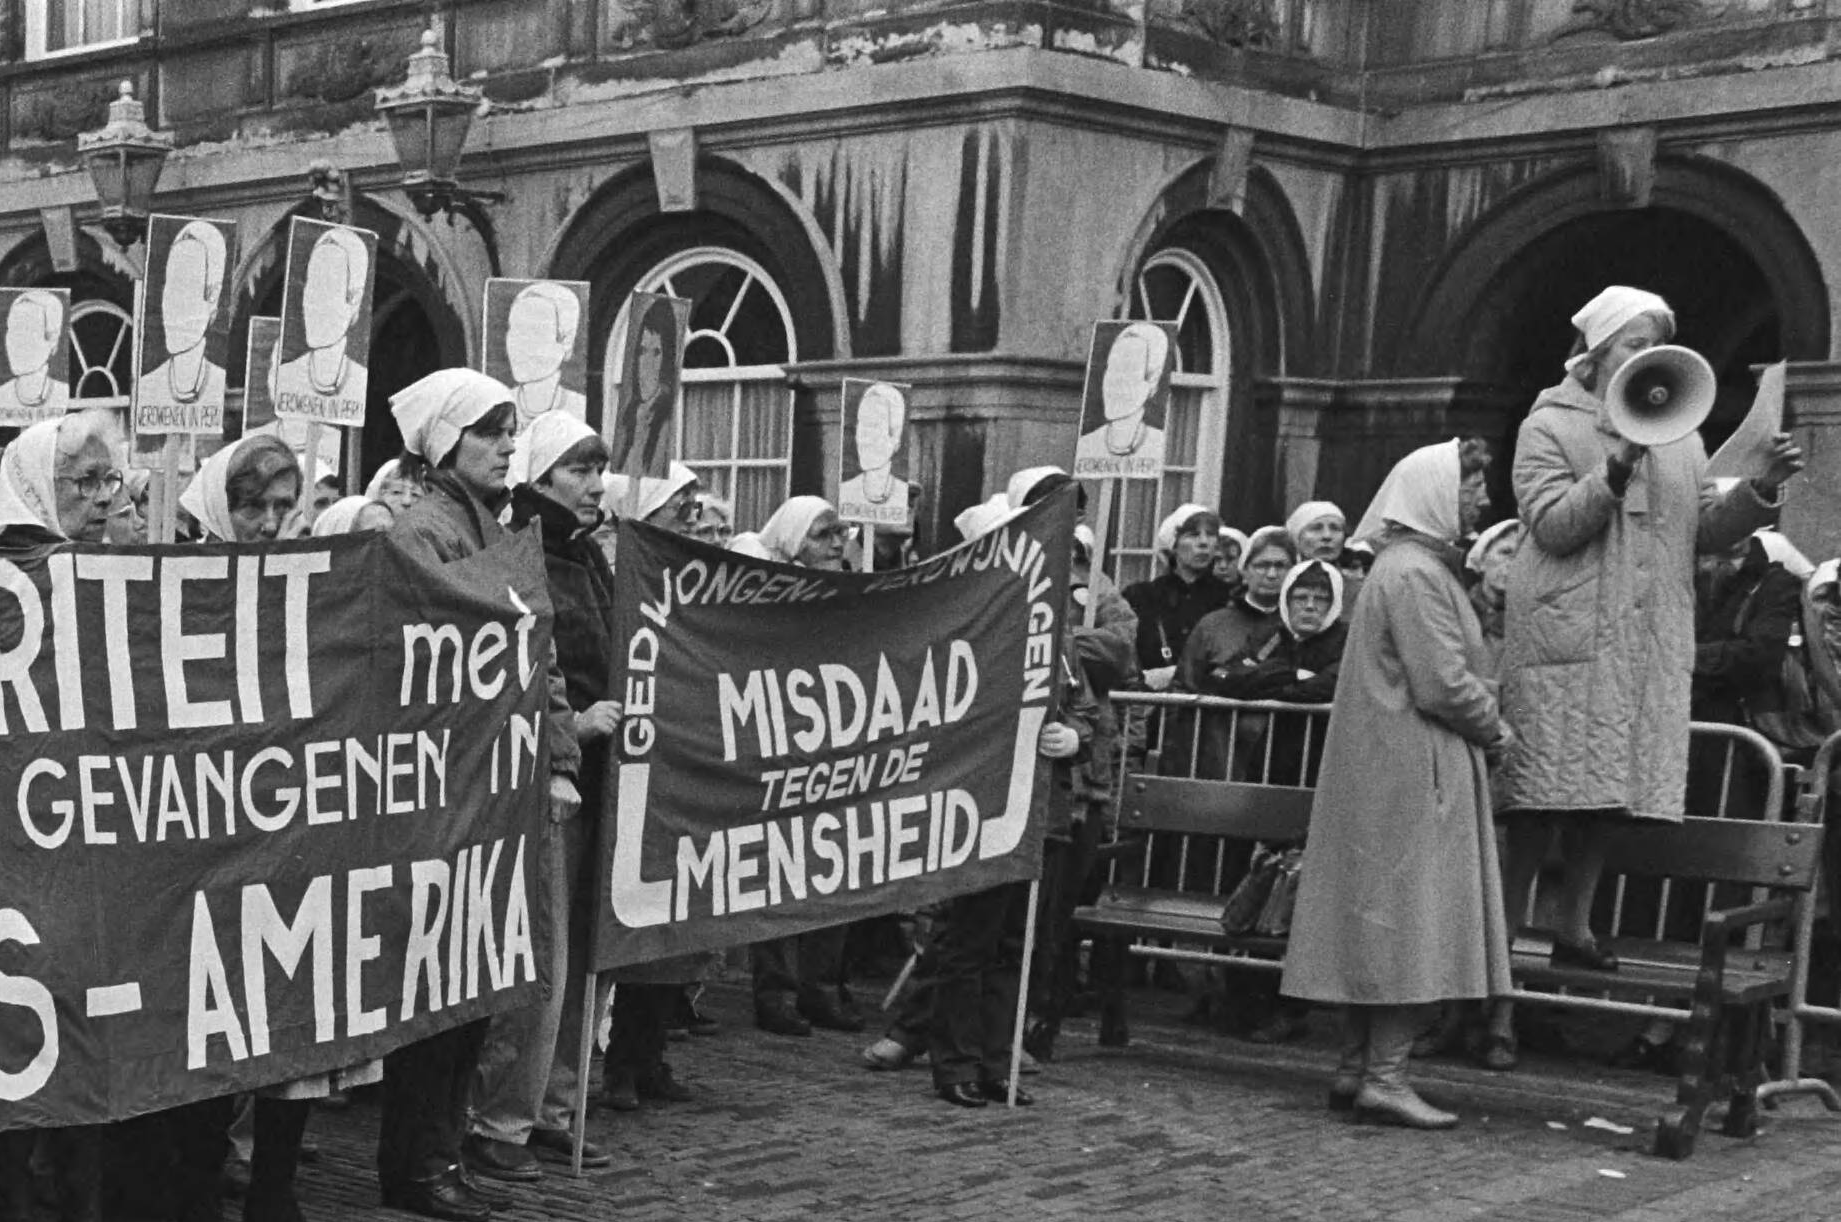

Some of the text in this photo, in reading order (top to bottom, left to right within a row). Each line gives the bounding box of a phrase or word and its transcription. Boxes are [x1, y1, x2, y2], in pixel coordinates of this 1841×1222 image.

[400, 586, 538, 705] met
[717, 638, 980, 763] MISDAAD
[17, 728, 452, 849] GEVANGENEN
[490, 711, 542, 795] IN
[761, 741, 930, 812] TEGEN DE
[675, 788, 980, 922] MENSHEID
